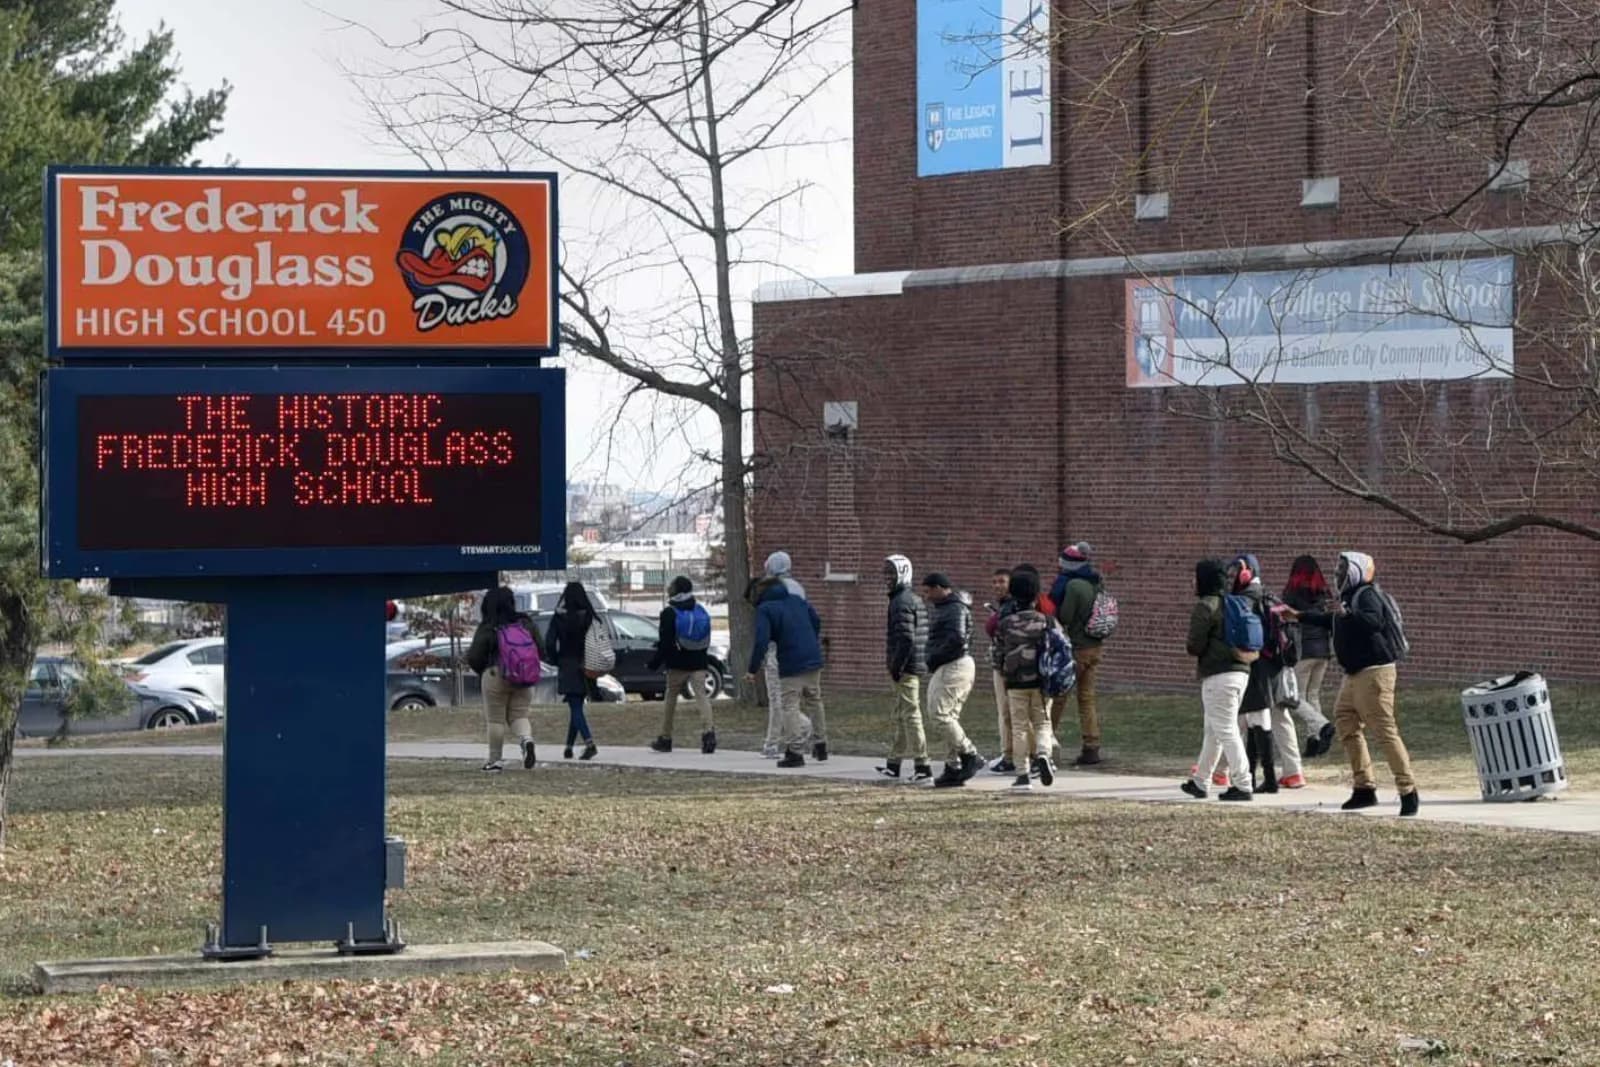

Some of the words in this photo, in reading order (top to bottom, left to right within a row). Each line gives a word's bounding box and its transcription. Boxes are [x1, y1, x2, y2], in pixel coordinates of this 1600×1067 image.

[79, 185, 379, 234] Frederick
[412, 203, 445, 234] THE
[450, 198, 517, 234] MIGHTY
[81, 239, 374, 301] Douglass
[75, 309, 164, 336] HIGH
[177, 309, 316, 337] SCHOOL
[327, 309, 386, 336] 450
[414, 284, 516, 329] Ducks
[1179, 289, 1205, 321] An
[1213, 284, 1260, 330] Early
[1352, 344, 1375, 370] City
[1379, 343, 1451, 364] Community
[178, 395, 250, 430] THE
[279, 394, 444, 429] HISTORIC
[97, 433, 300, 469] FREDERICK
[327, 431, 513, 466] DOUGLASS
[186, 471, 267, 507] HIGH
[294, 469, 434, 505] SCHOOL
[460, 545, 541, 555] STEWARTSIGNS.COM
